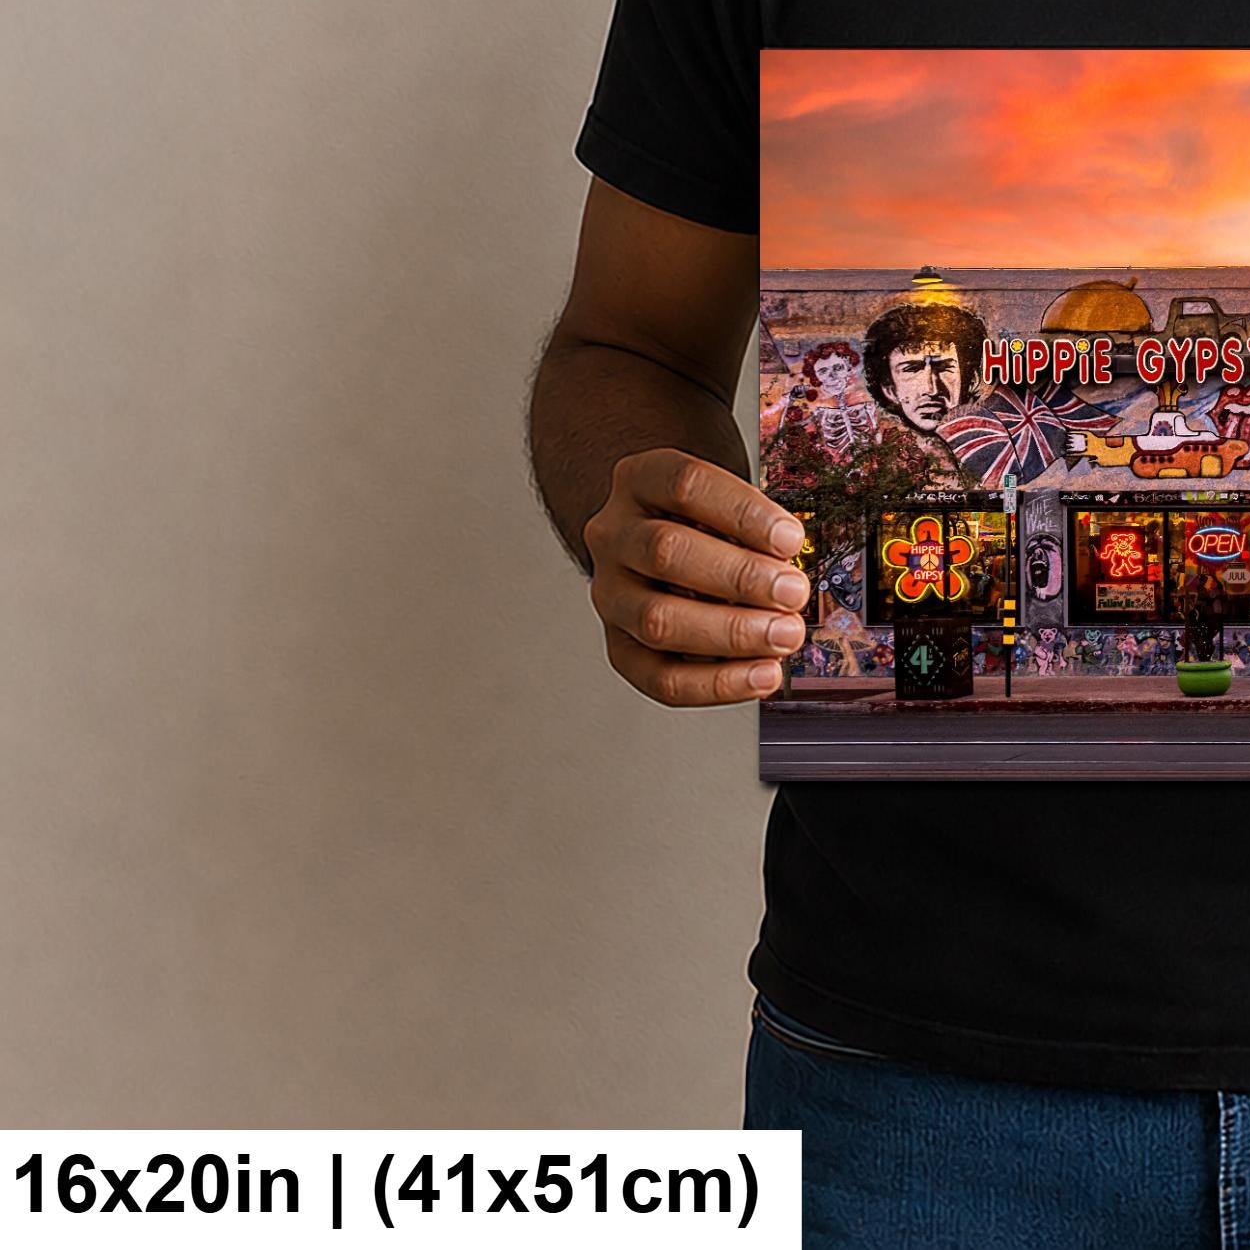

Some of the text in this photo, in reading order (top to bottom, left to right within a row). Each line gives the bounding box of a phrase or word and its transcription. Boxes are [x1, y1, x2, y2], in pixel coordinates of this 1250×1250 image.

[1188, 534, 1246, 553] OPEN
[911, 545, 944, 555] HIPPIE
[914, 569, 944, 581] GYPSY
[1228, 571, 1247, 581] JUUL
